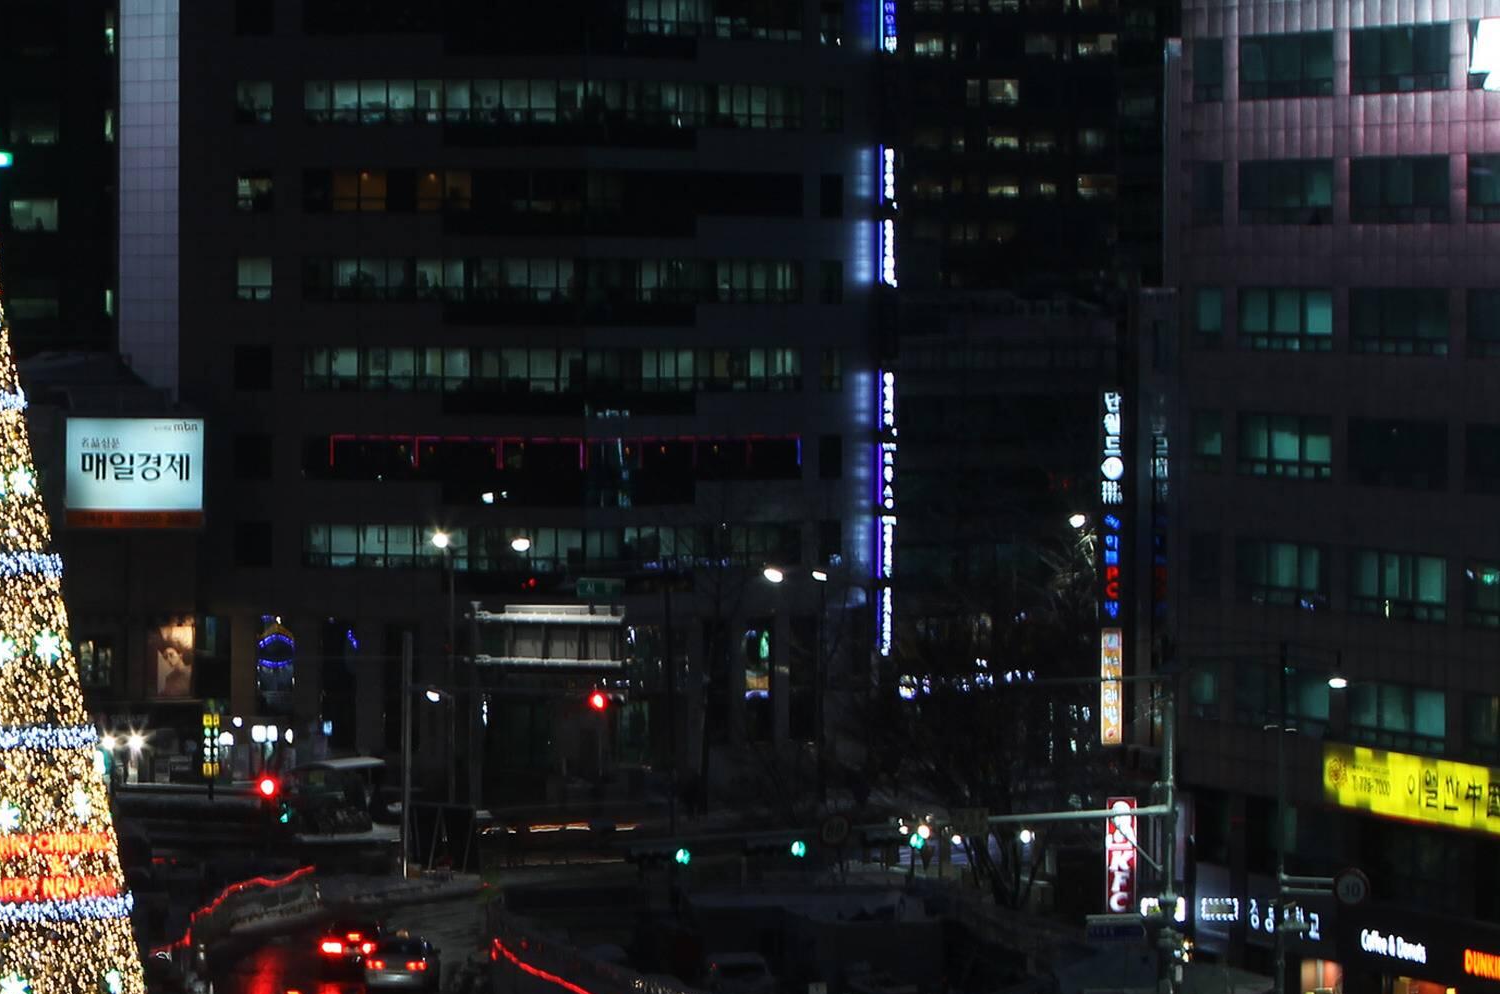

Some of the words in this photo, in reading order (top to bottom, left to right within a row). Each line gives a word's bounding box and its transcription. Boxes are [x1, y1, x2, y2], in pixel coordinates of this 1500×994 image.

[173, 420, 198, 432] mbn
[1103, 392, 1122, 456] 단월드
[81, 452, 191, 482] 매일경제
[41, 876, 81, 900] NEW
[1109, 850, 1135, 913] KFC
[1361, 928, 1388, 956] Coffee
[1396, 936, 1427, 964] Donuts
[1464, 948, 1500, 982] DUNKI
